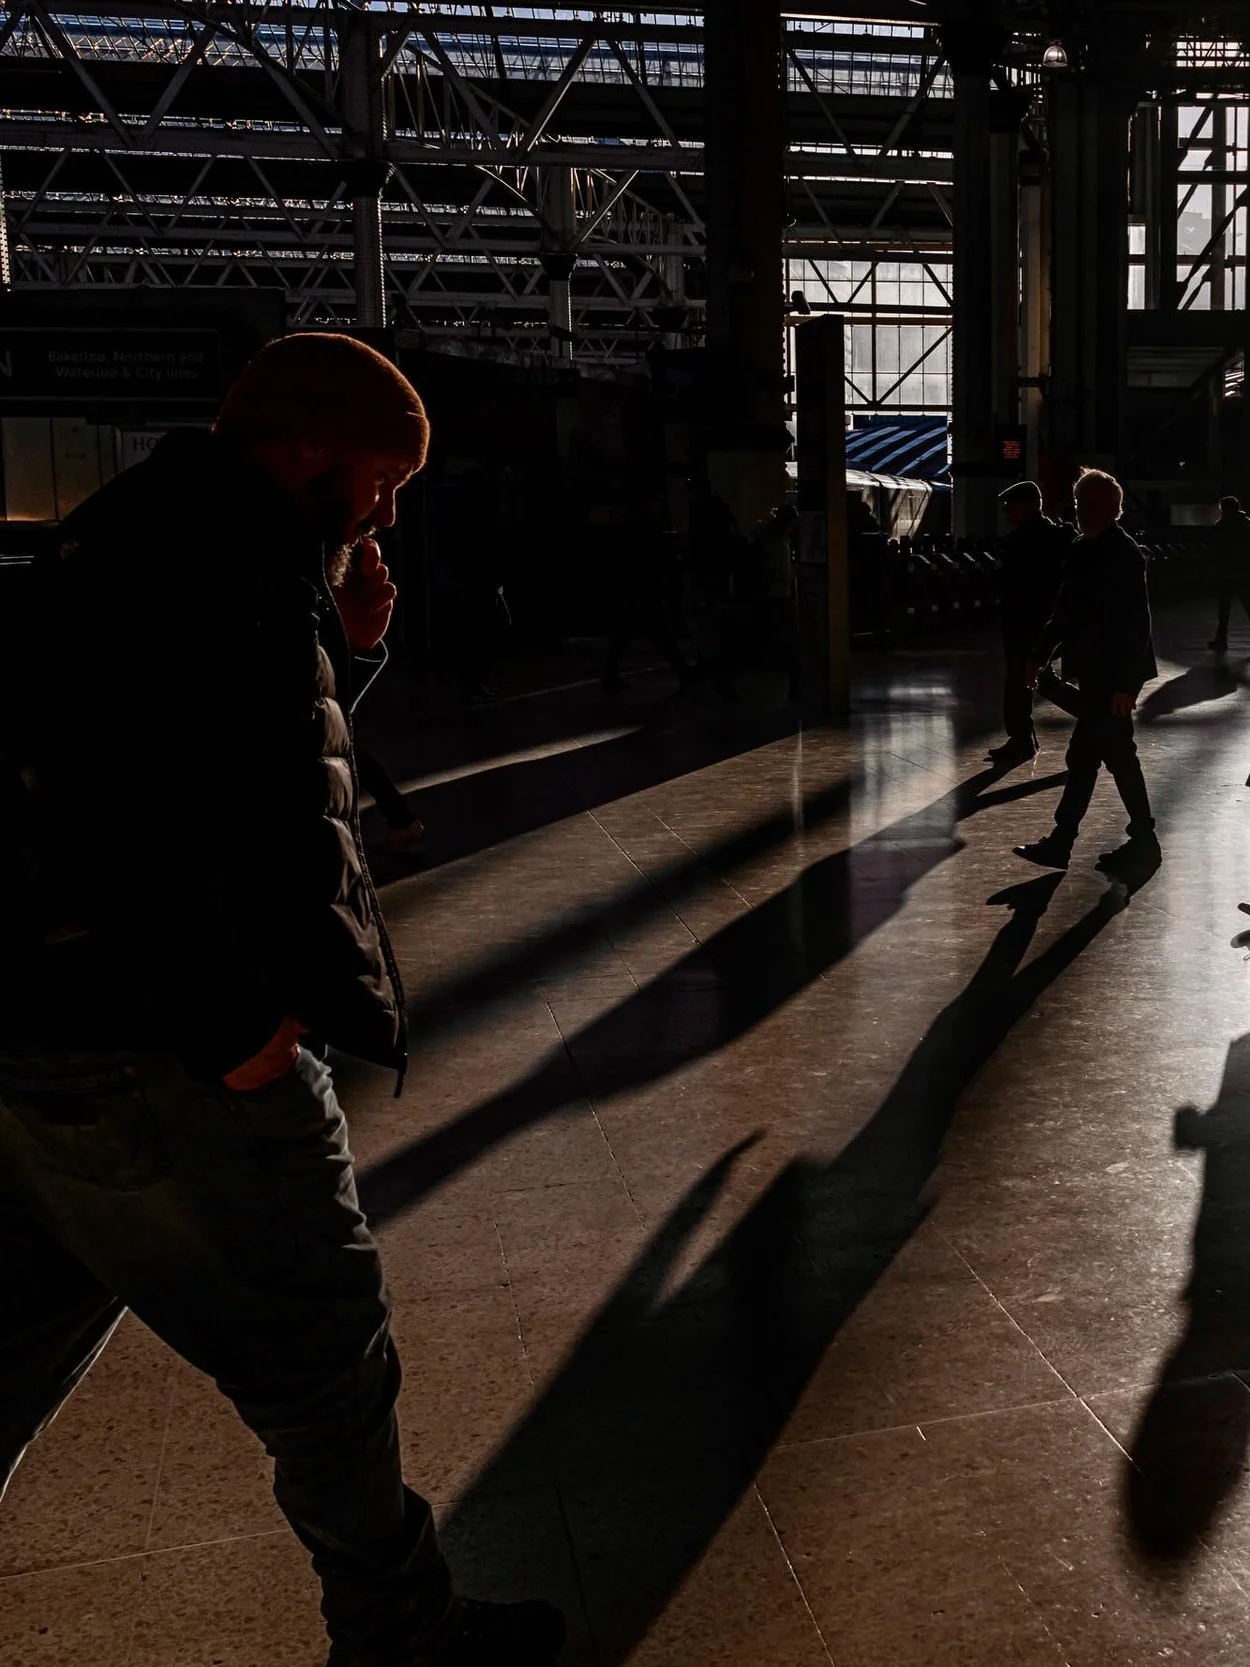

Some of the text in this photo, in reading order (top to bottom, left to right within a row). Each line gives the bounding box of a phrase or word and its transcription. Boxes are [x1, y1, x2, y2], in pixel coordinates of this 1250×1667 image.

[112, 349, 176, 363] Northern
[178, 350, 204, 363] and
[54, 365, 118, 379] Waterloo
[122, 365, 132, 379] &
[135, 365, 162, 382] City
